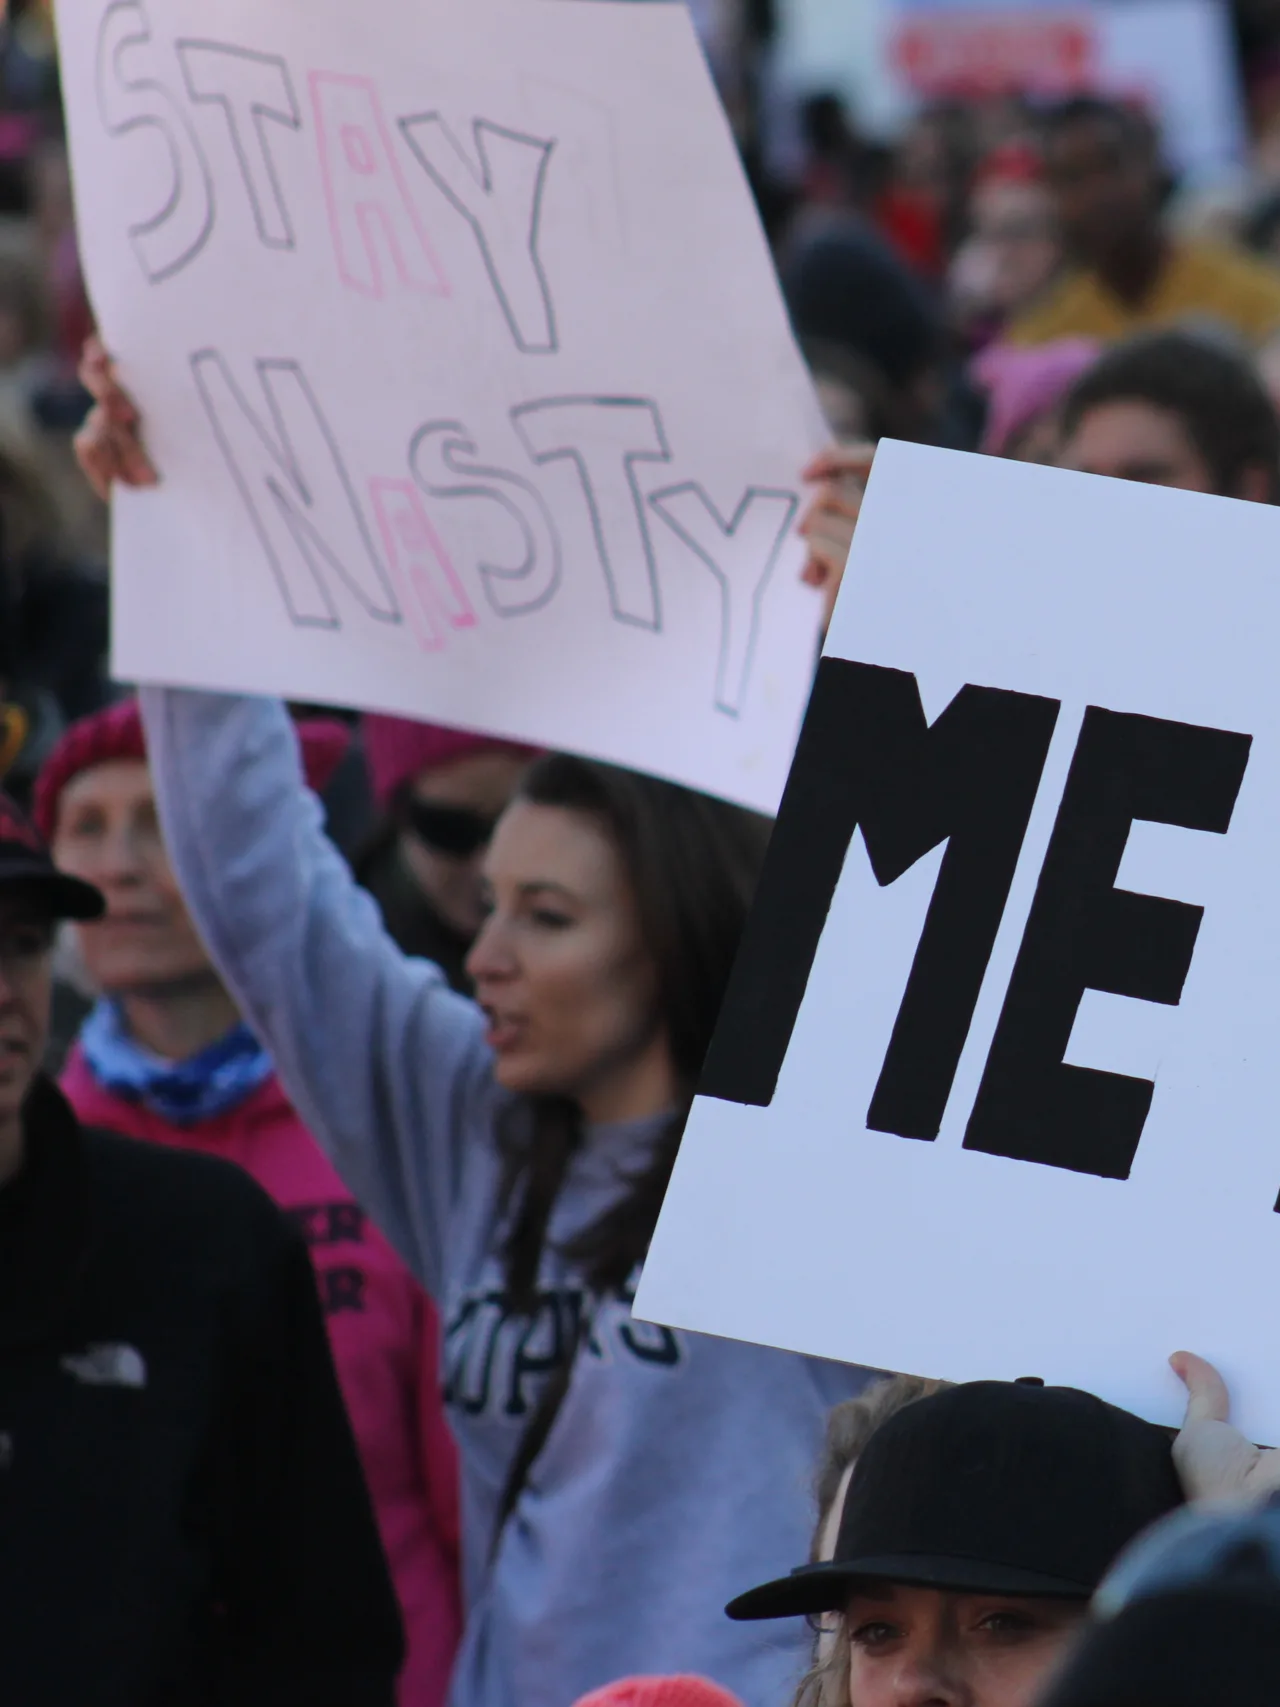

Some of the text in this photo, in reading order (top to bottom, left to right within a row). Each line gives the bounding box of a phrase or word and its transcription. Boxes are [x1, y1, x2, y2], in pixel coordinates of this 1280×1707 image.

[96, 0, 556, 354] STAY
[190, 349, 800, 721] NASTY
[692, 656, 1254, 1180] ME
